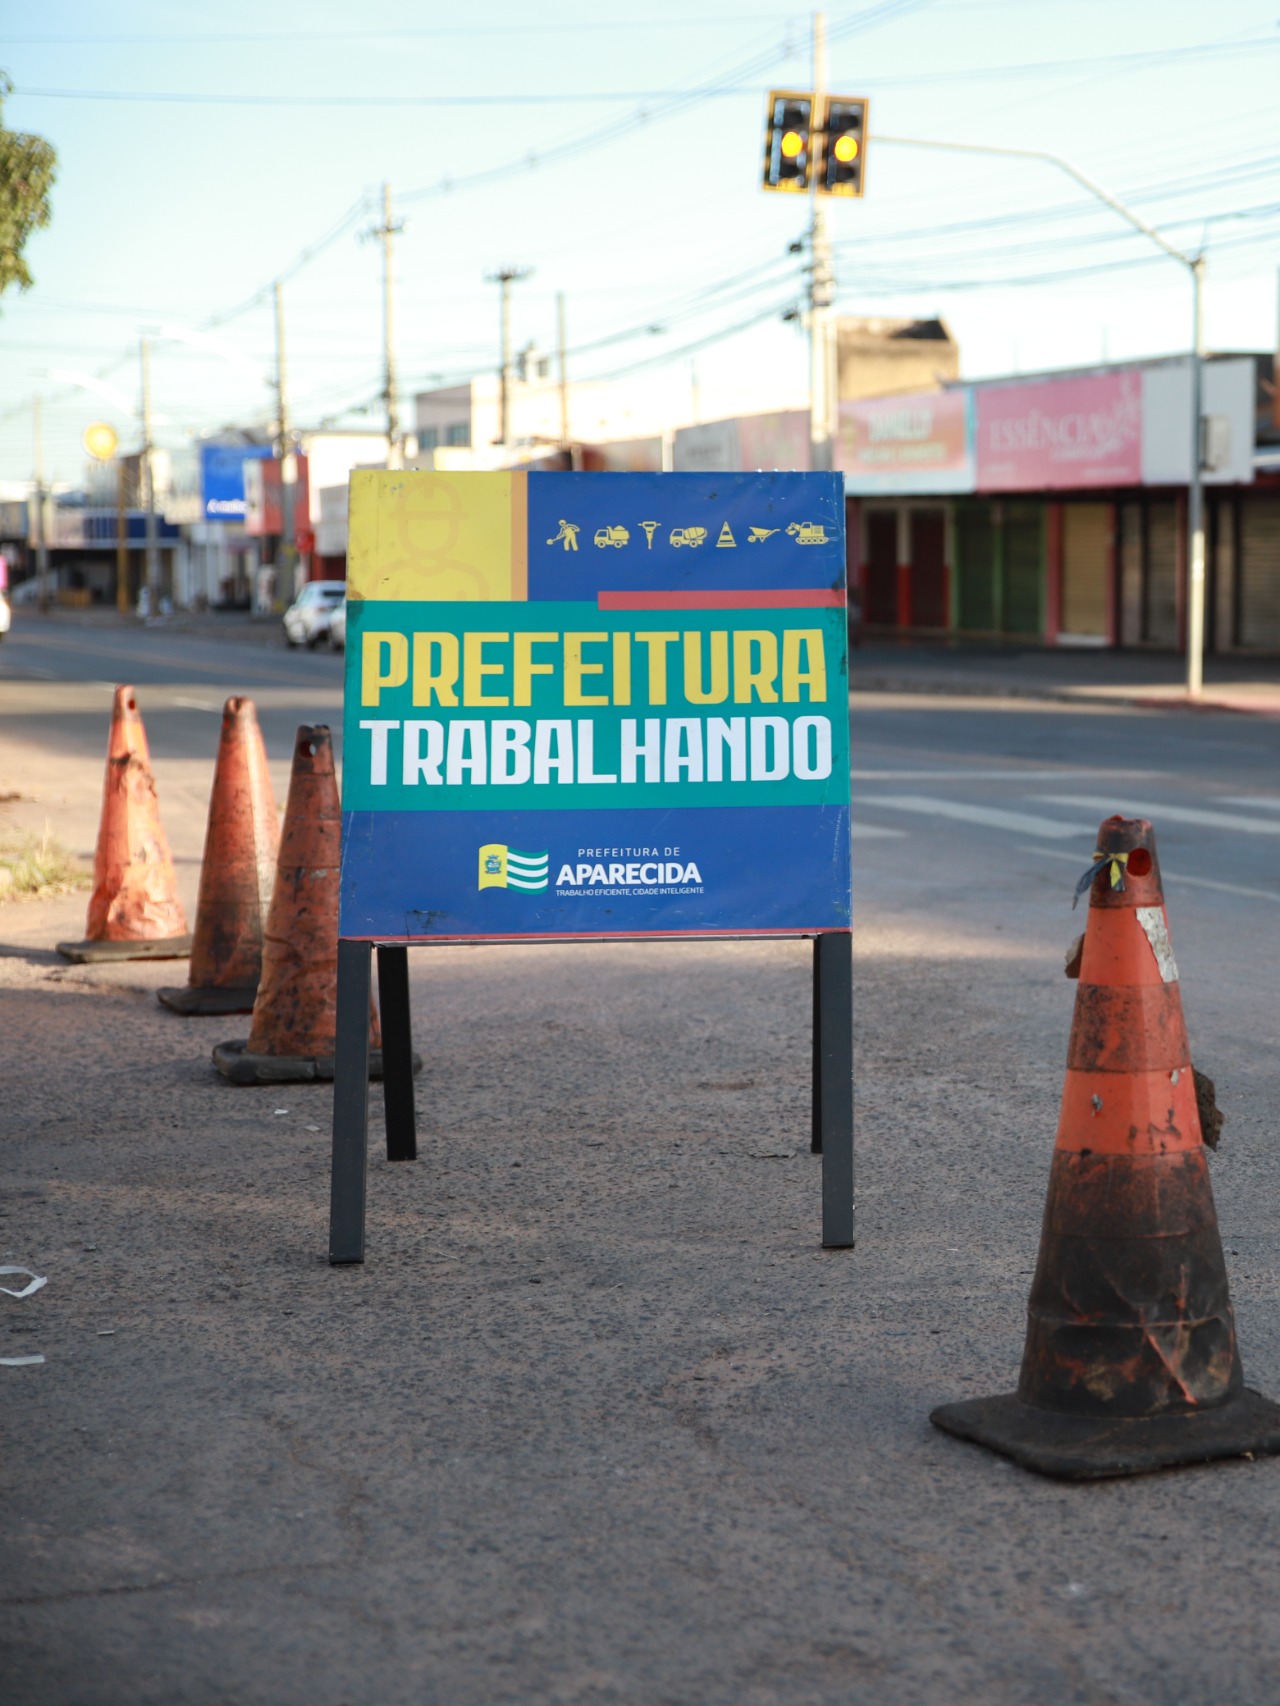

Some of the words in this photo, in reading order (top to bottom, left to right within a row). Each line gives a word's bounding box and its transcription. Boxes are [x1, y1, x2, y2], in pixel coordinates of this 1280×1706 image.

[361, 629, 828, 708] PREFEITURA
[359, 715, 832, 786] TRABALHANDO
[577, 847, 659, 858] PREFEITURA
[664, 846, 680, 857] DE
[555, 862, 703, 886] APARECIDA
[556, 888, 594, 897] TRABALHO
[594, 888, 632, 896] EFICIENTE,
[632, 887, 659, 896] CIDADE
[659, 886, 705, 895] INTELIGENTE
